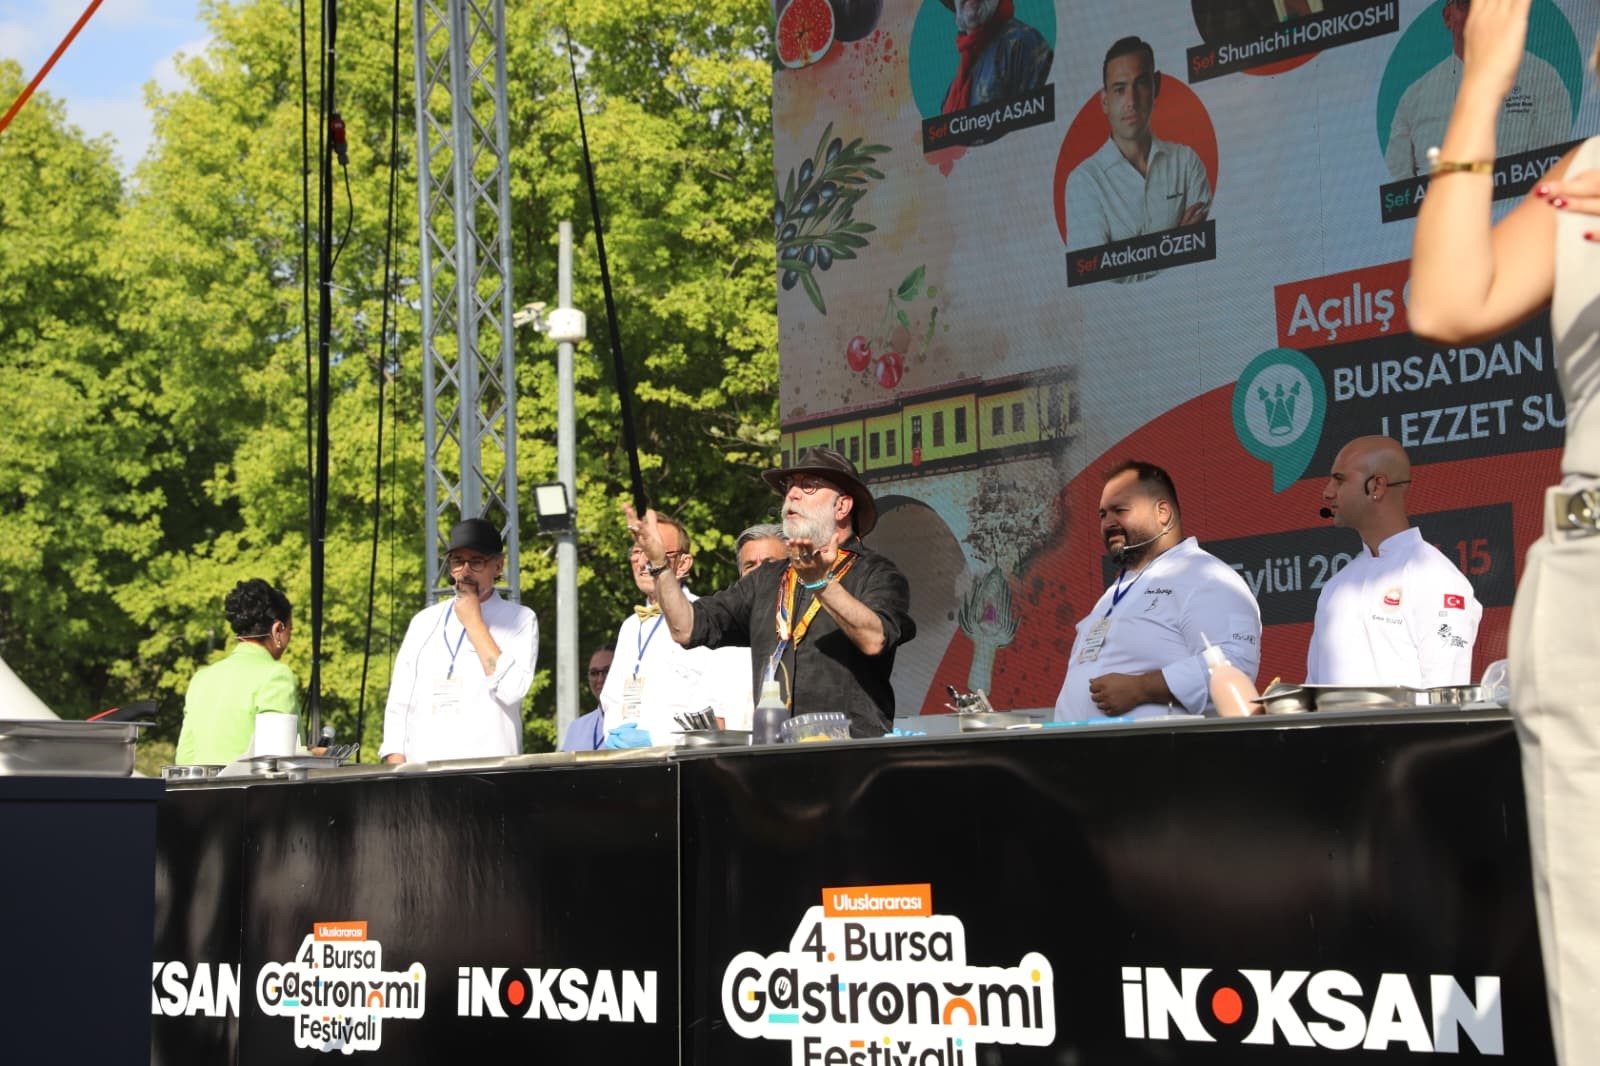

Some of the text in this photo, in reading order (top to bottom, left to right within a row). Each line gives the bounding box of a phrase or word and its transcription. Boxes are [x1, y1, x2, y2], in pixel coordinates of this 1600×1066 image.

[1218, 28, 1291, 65] Shunichi
[1293, 8, 1394, 46] HORIKOSHI
[949, 109, 1001, 135] Cüneyt
[1003, 96, 1046, 122] ASAN
[1385, 191, 1410, 213] Şef
[1076, 231, 1206, 273] Şef Atakan ÖZEN
[1287, 283, 1394, 341] Açılış
[1521, 393, 1567, 431] SU
[1229, 555, 1302, 598] ylül
[833, 893, 922, 911] Uluslararası
[302, 943, 375, 969] 4. Bursa
[802, 922, 953, 962] 4. Bursa
[262, 971, 420, 1009] Gastronomi
[731, 967, 1044, 1029] Gastronomi
[300, 1014, 376, 1045] Festivali
